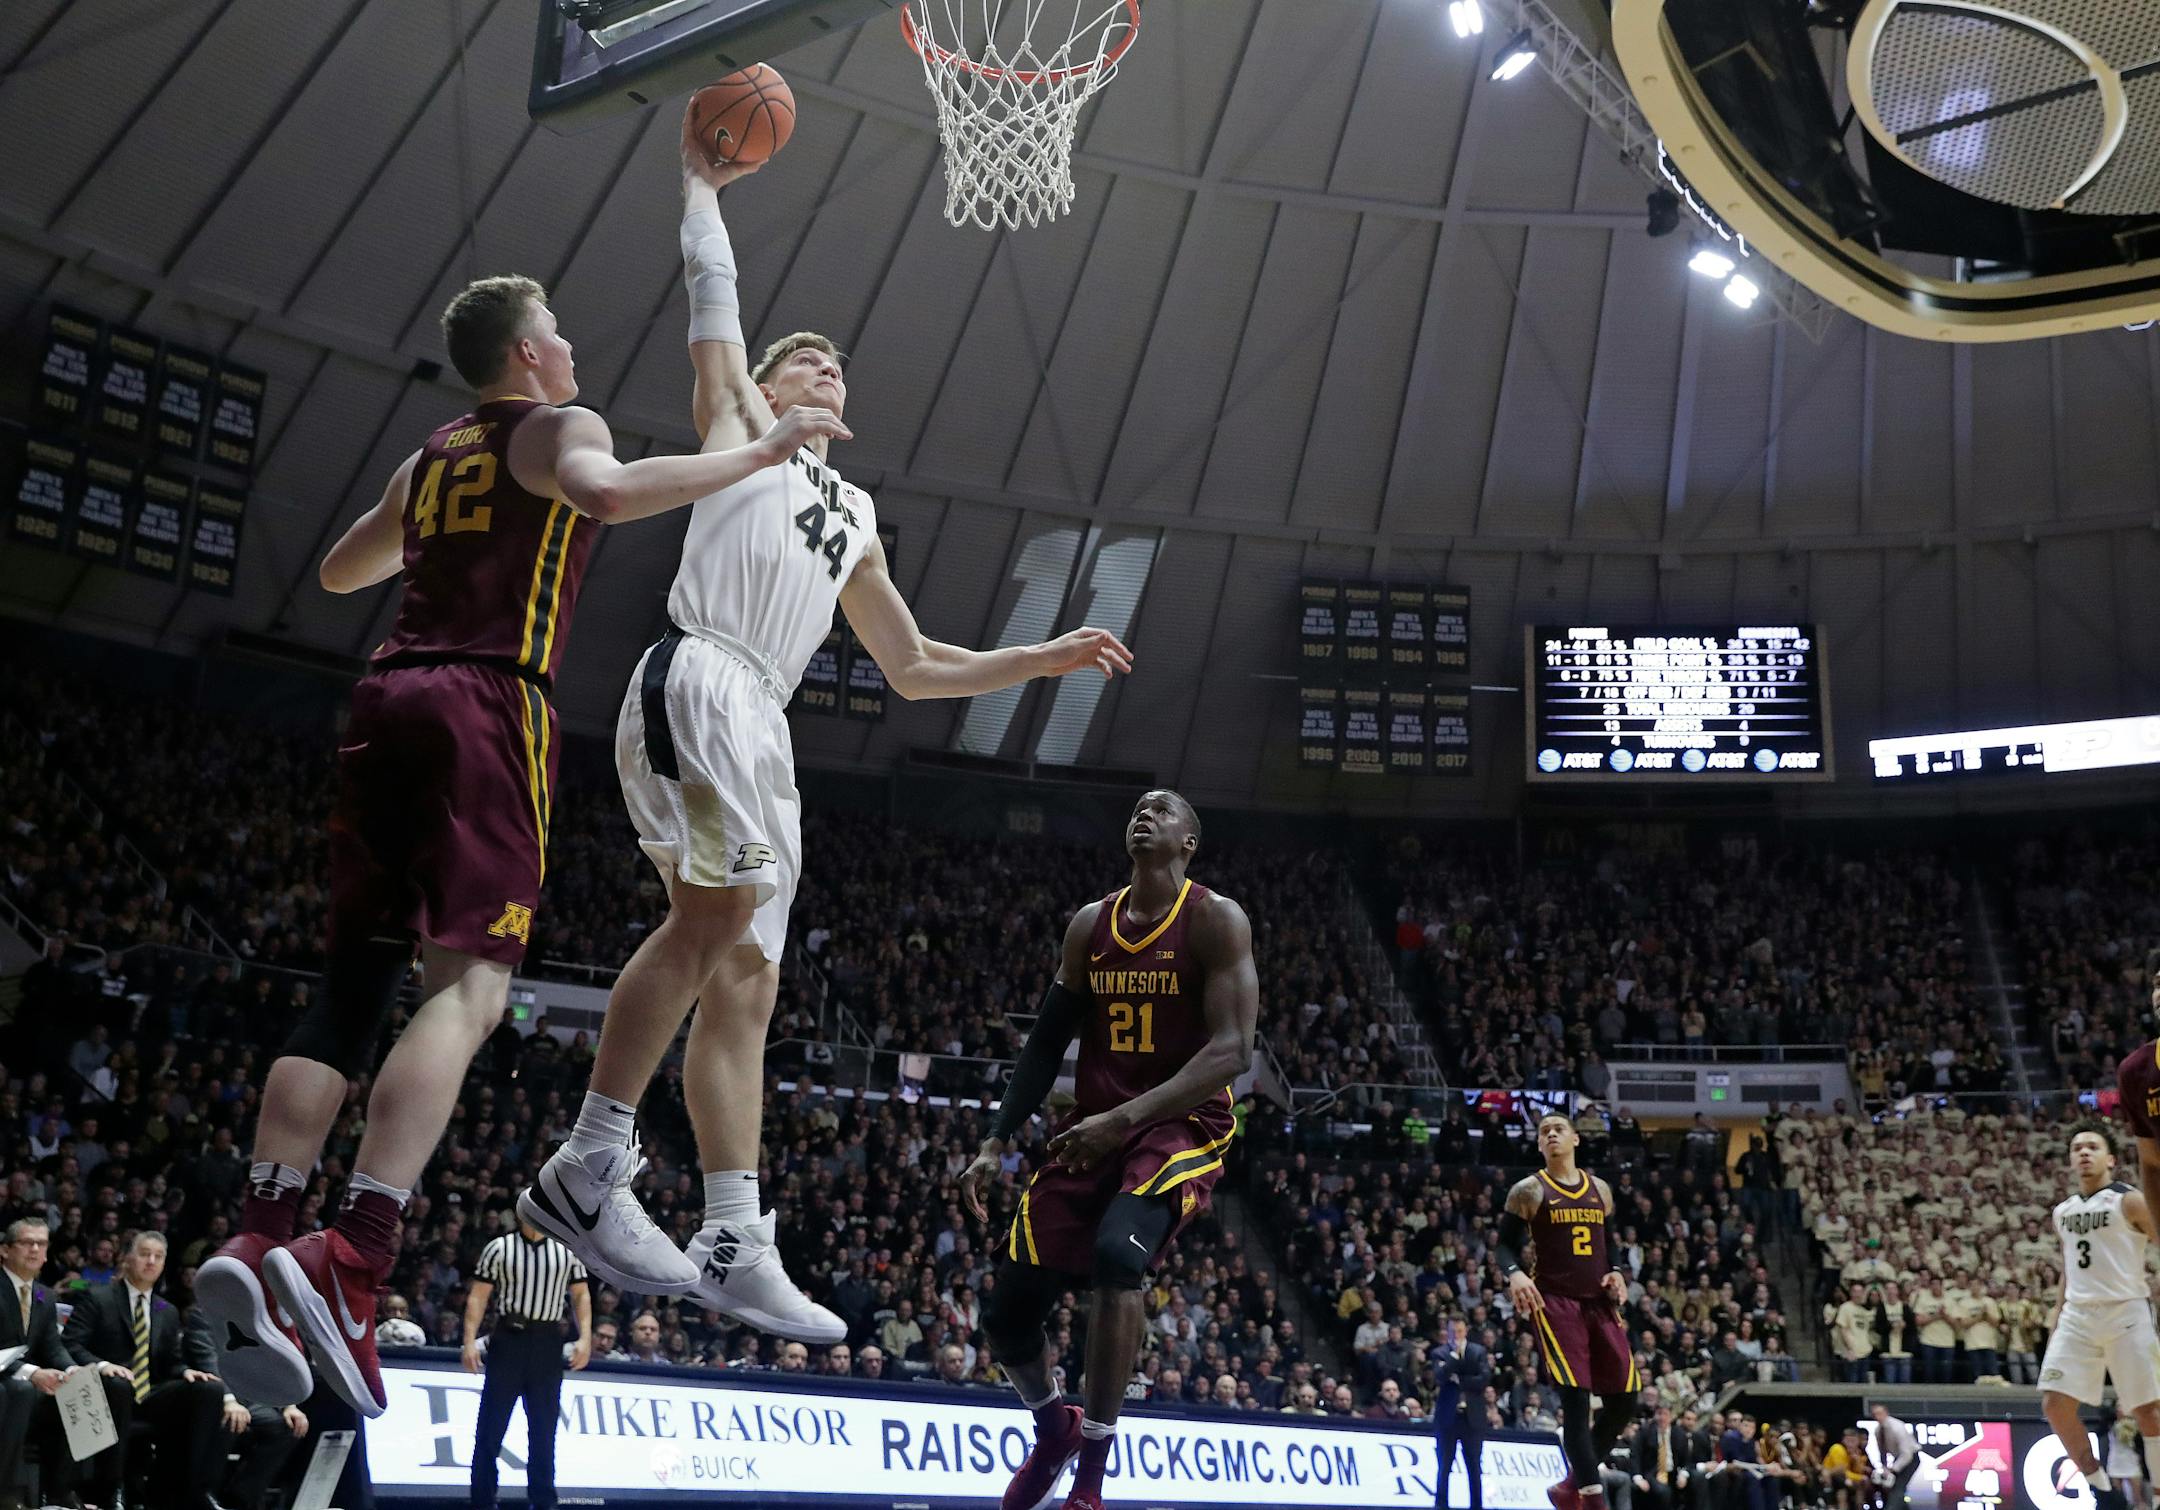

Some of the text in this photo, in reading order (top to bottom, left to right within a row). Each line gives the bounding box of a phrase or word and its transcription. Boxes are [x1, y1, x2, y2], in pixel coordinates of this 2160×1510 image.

[414, 451, 498, 539] 42
[795, 502, 848, 581] 44
[1436, 754, 1467, 767] 2017
[1089, 971, 1180, 995] MINNESOTA
[1108, 1002, 1155, 1053] 21
[2061, 1211, 2110, 1234] PURDUE
[1572, 1225, 1593, 1256] 2
[2077, 1240, 2091, 1269] 3
[555, 1394, 853, 1446] MIKE RAISOR
[692, 1455, 760, 1480] BUICK
[1492, 1450, 1566, 1478] RAISOR
